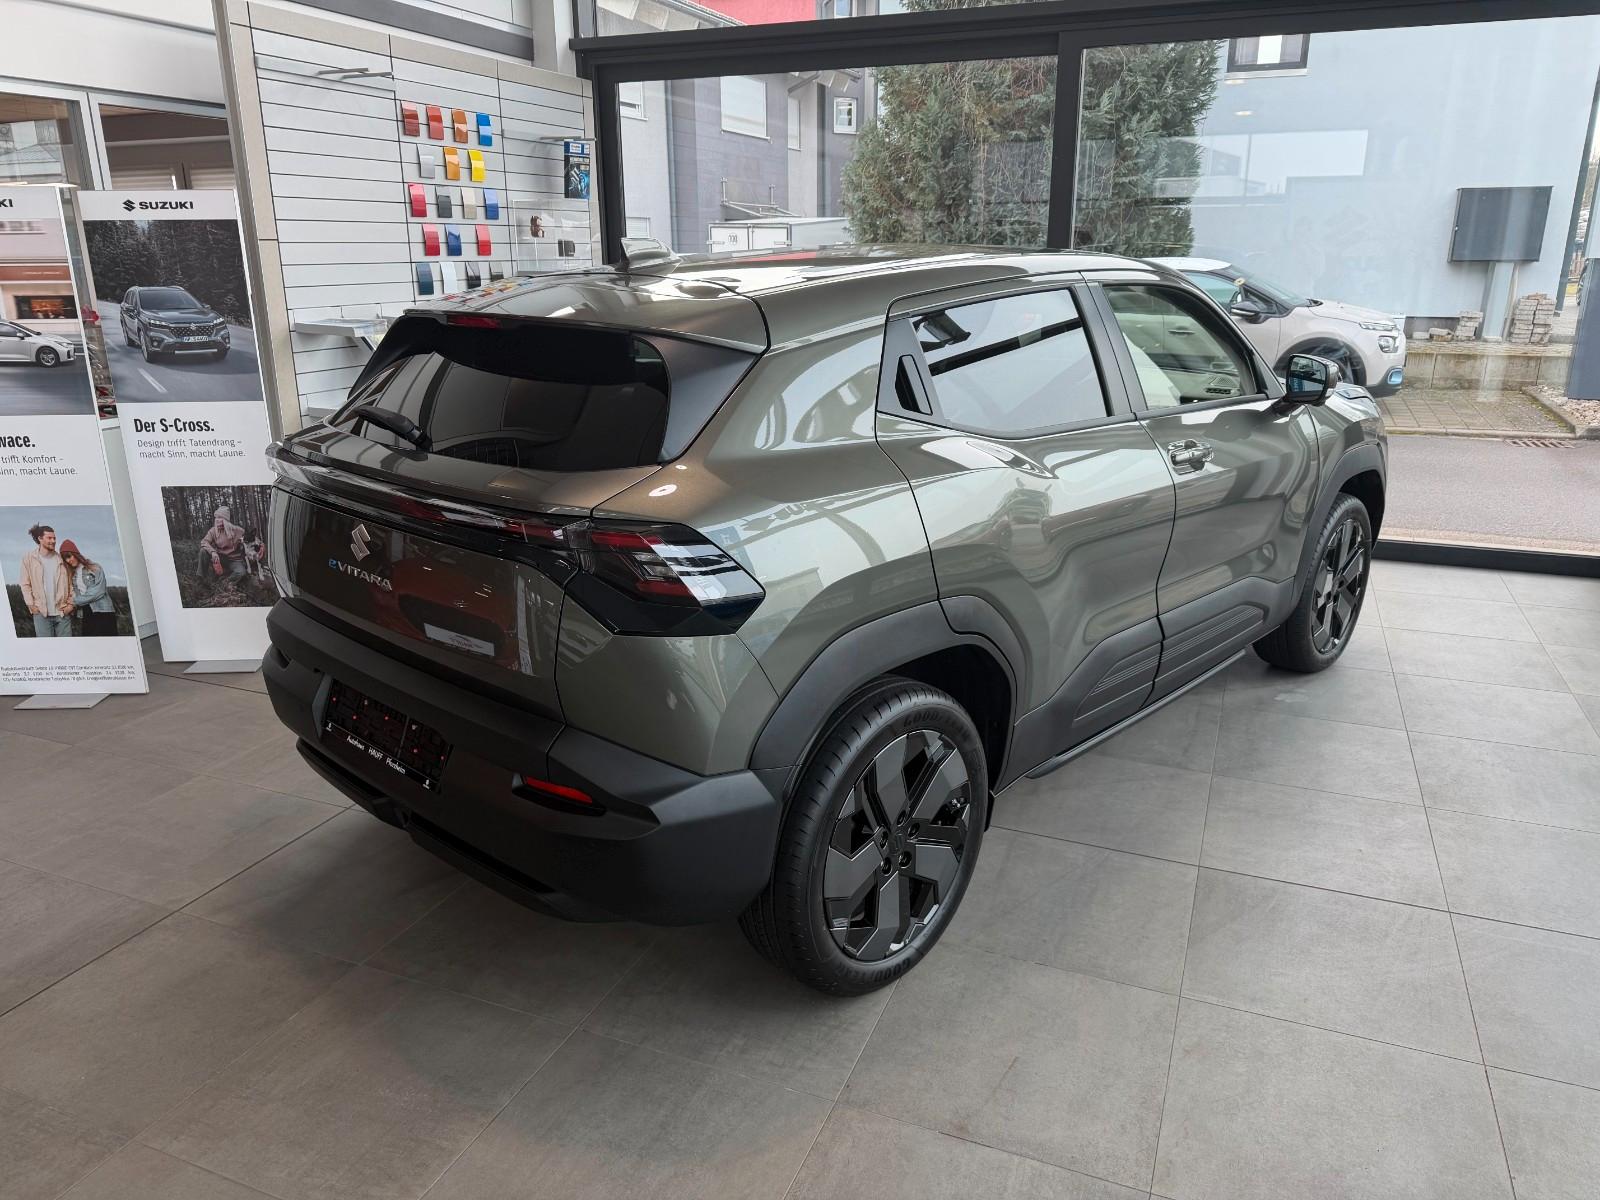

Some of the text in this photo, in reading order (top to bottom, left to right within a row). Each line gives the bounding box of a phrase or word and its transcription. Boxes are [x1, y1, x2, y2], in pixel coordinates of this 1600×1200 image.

[138, 201, 194, 209] SUZUKI
[134, 418, 215, 432] Der S-Cross.
[137, 439, 165, 448] Design
[167, 438, 187, 447] trifft
[189, 438, 236, 447] Tatendrang
[140, 448, 246, 458] macht Sinn, macht Laune.
[1, 454, 20, 463] trifft
[22, 455, 56, 463] Komfort
[0, 466, 78, 476] inn, macht Laune.
